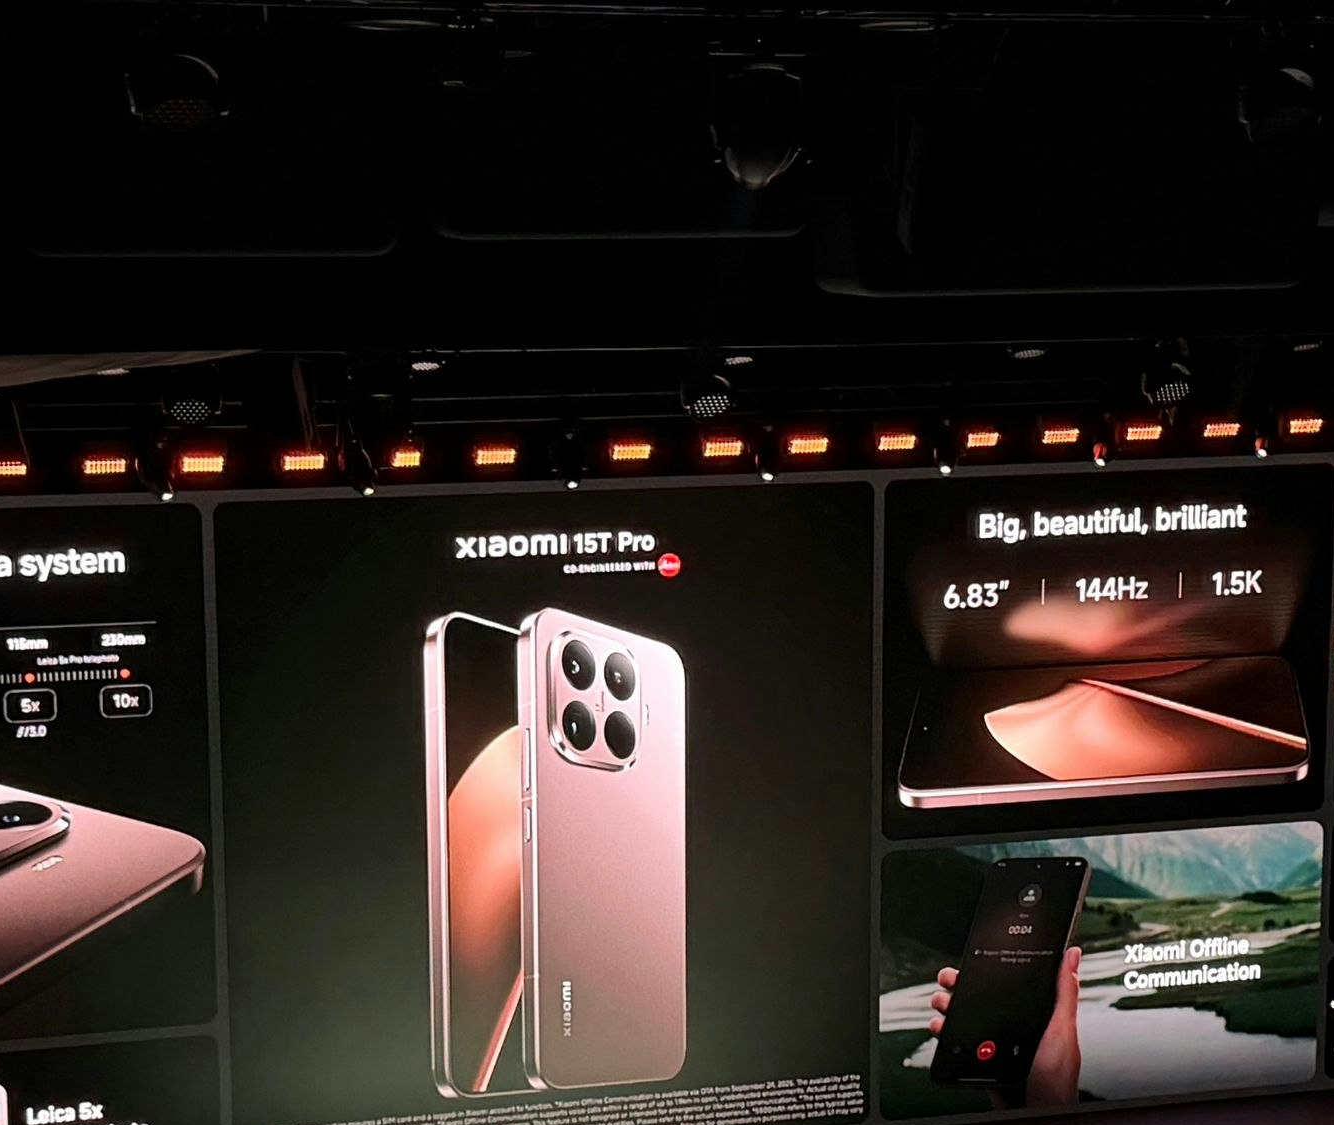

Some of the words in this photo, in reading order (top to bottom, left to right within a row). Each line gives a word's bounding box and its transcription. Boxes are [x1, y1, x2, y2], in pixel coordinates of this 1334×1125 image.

[978, 513, 1027, 544] Big,
[1033, 507, 1148, 537] beautiful,
[1155, 504, 1247, 532] brilliant
[573, 532, 612, 554] 15T
[617, 531, 656, 552] Pro
[20, 549, 125, 582] system
[633, 561, 656, 571] WITH
[1075, 576, 1149, 602] 144Hz
[1212, 569, 1263, 596] 1.5K
[101, 633, 146, 646] 230mm
[20, 698, 40, 713] 5x
[112, 693, 139, 708] 10x
[1124, 940, 1186, 963] Xiaomi
[1189, 936, 1250, 958] Offline
[1123, 961, 1261, 990] Communication
[26, 1105, 76, 1125] Leica
[79, 1102, 104, 1120] 5x
